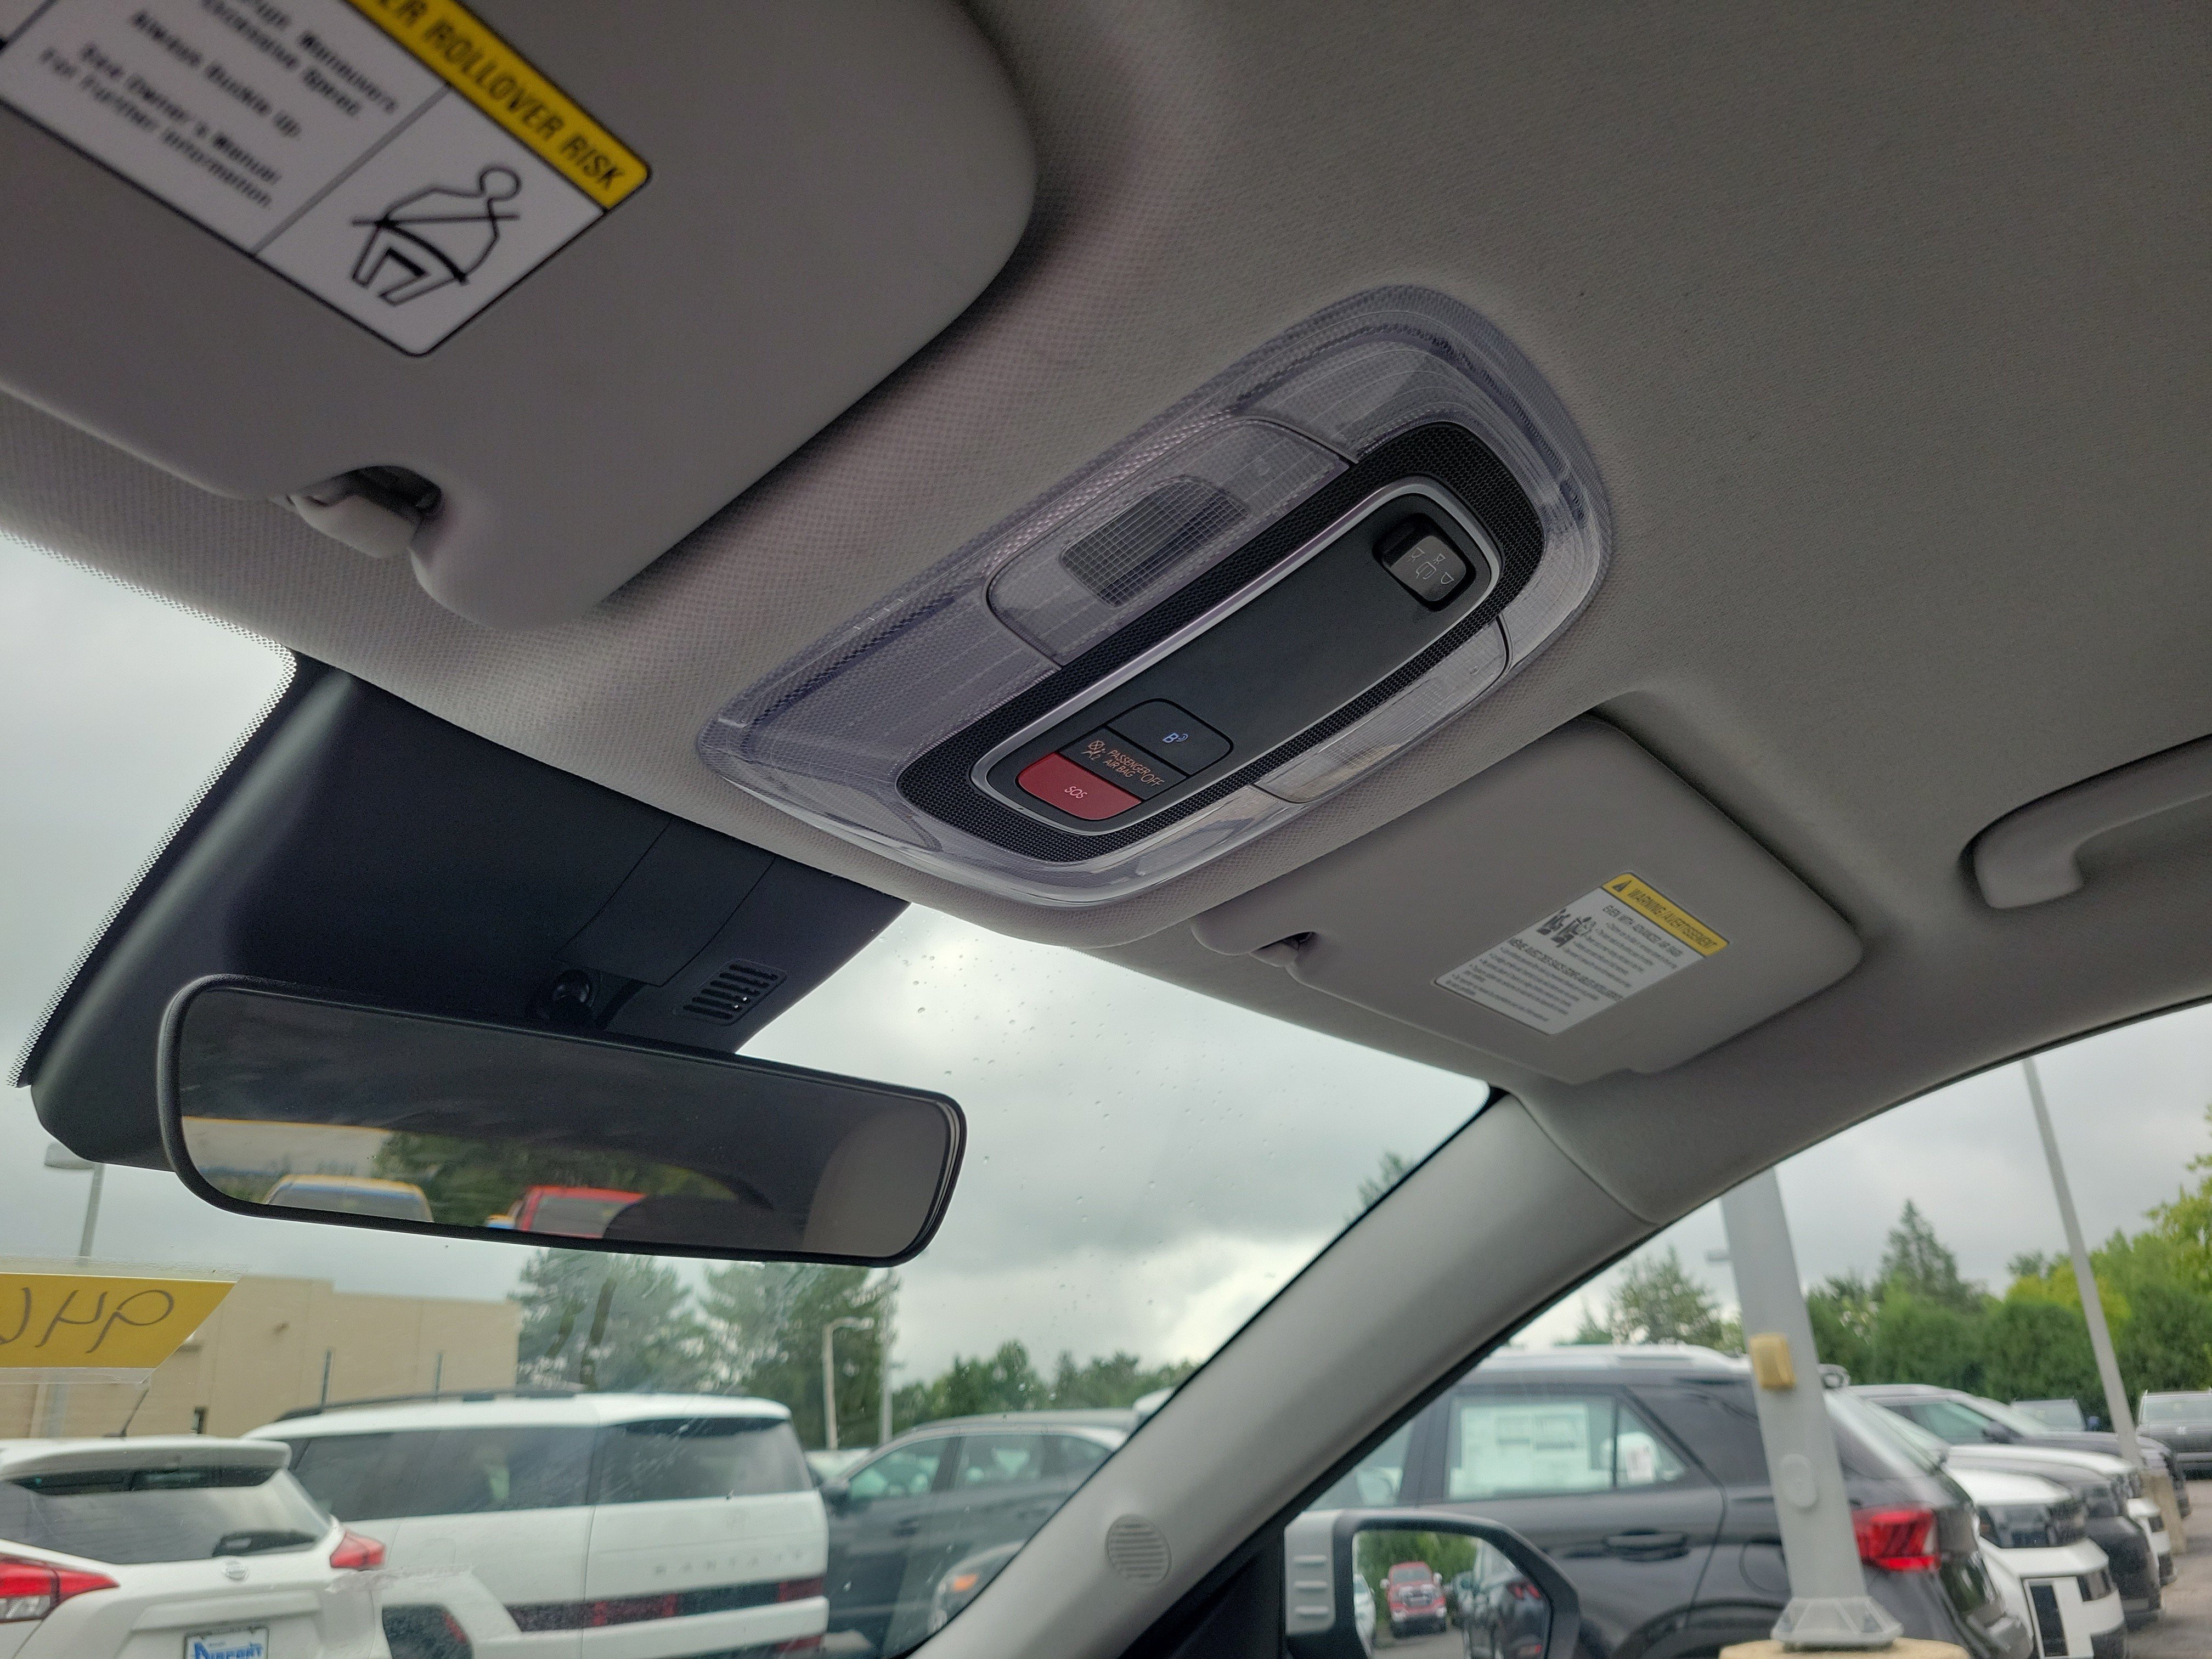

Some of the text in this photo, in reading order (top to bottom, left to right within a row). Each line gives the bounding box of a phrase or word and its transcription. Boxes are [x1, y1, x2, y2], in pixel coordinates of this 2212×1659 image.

[129, 8, 202, 69] Always
[205, 61, 272, 117] Buckle
[40, 46, 78, 80] For
[81, 74, 160, 132] Further
[82, 42, 125, 81] See
[212, 131, 281, 185] Manual
[424, 18, 565, 142] ROLLOVER
[560, 134, 624, 190] RISK
[1103, 759, 1136, 777] AIR BAG
[1107, 749, 1151, 776] PASSENGER
[1064, 786, 1088, 799] SOS
[1141, 774, 1165, 787] OFF
[1627, 888, 1666, 915] WARNING
